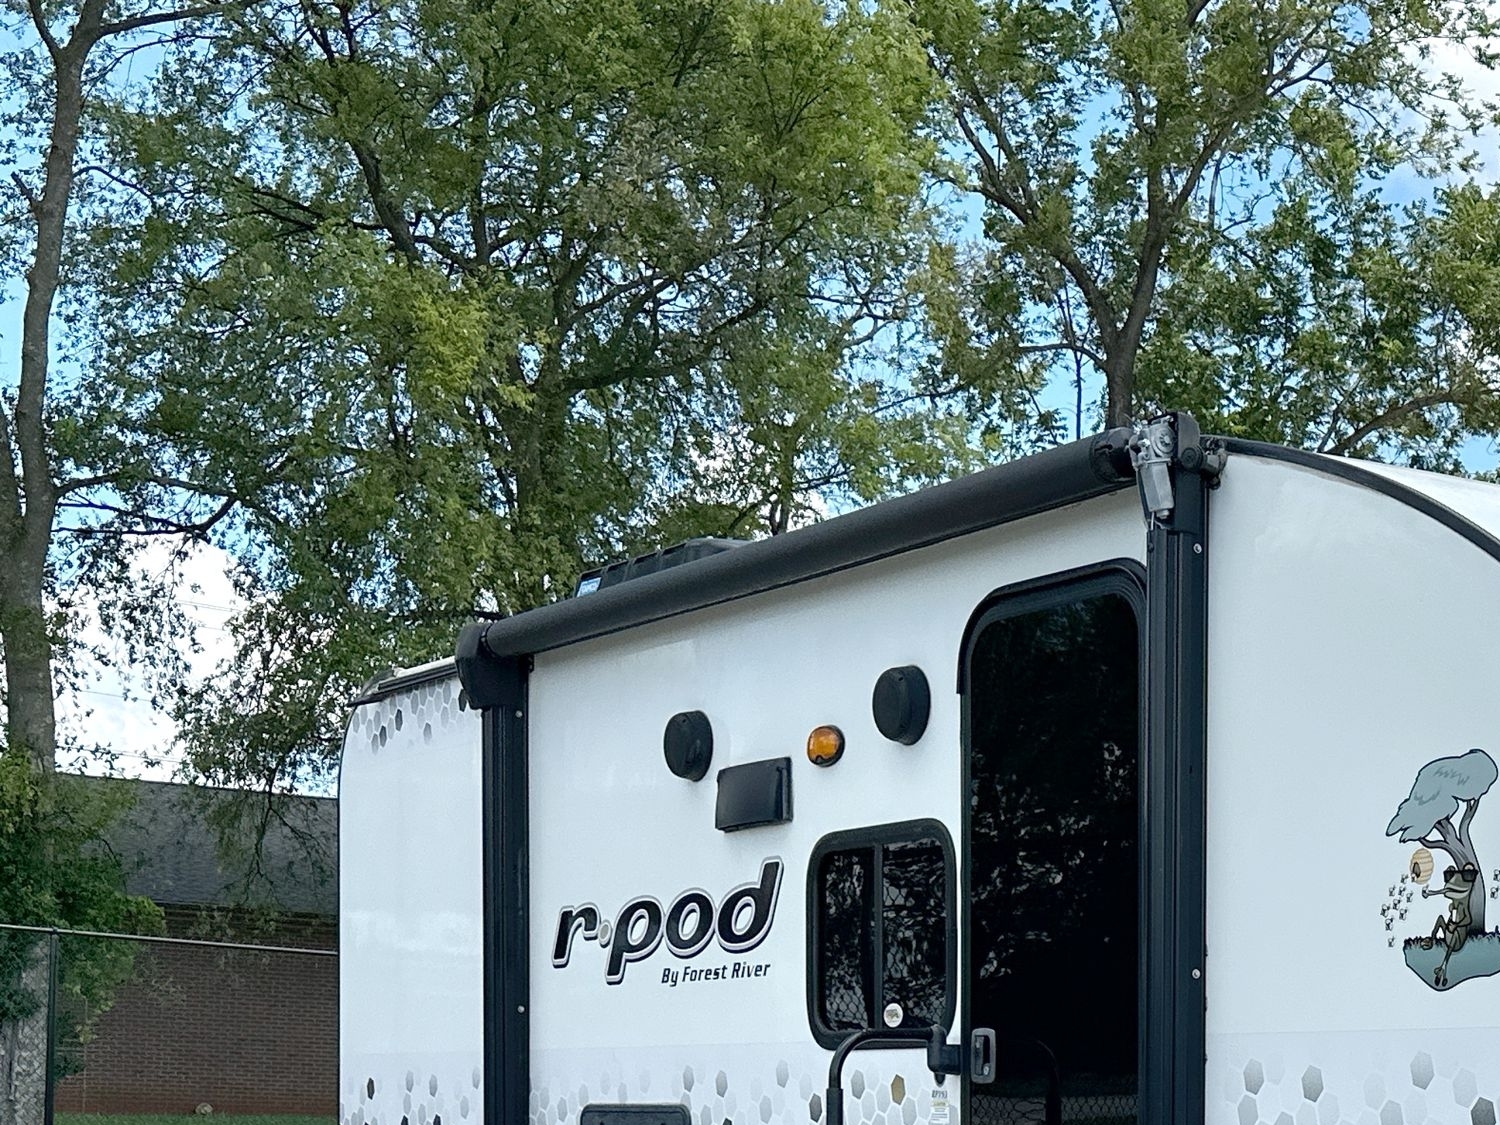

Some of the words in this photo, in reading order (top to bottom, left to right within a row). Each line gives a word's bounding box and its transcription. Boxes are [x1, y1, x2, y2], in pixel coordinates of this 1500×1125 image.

[661, 967, 679, 987] By
[682, 965, 728, 982] Forest
[731, 962, 771, 979] River
